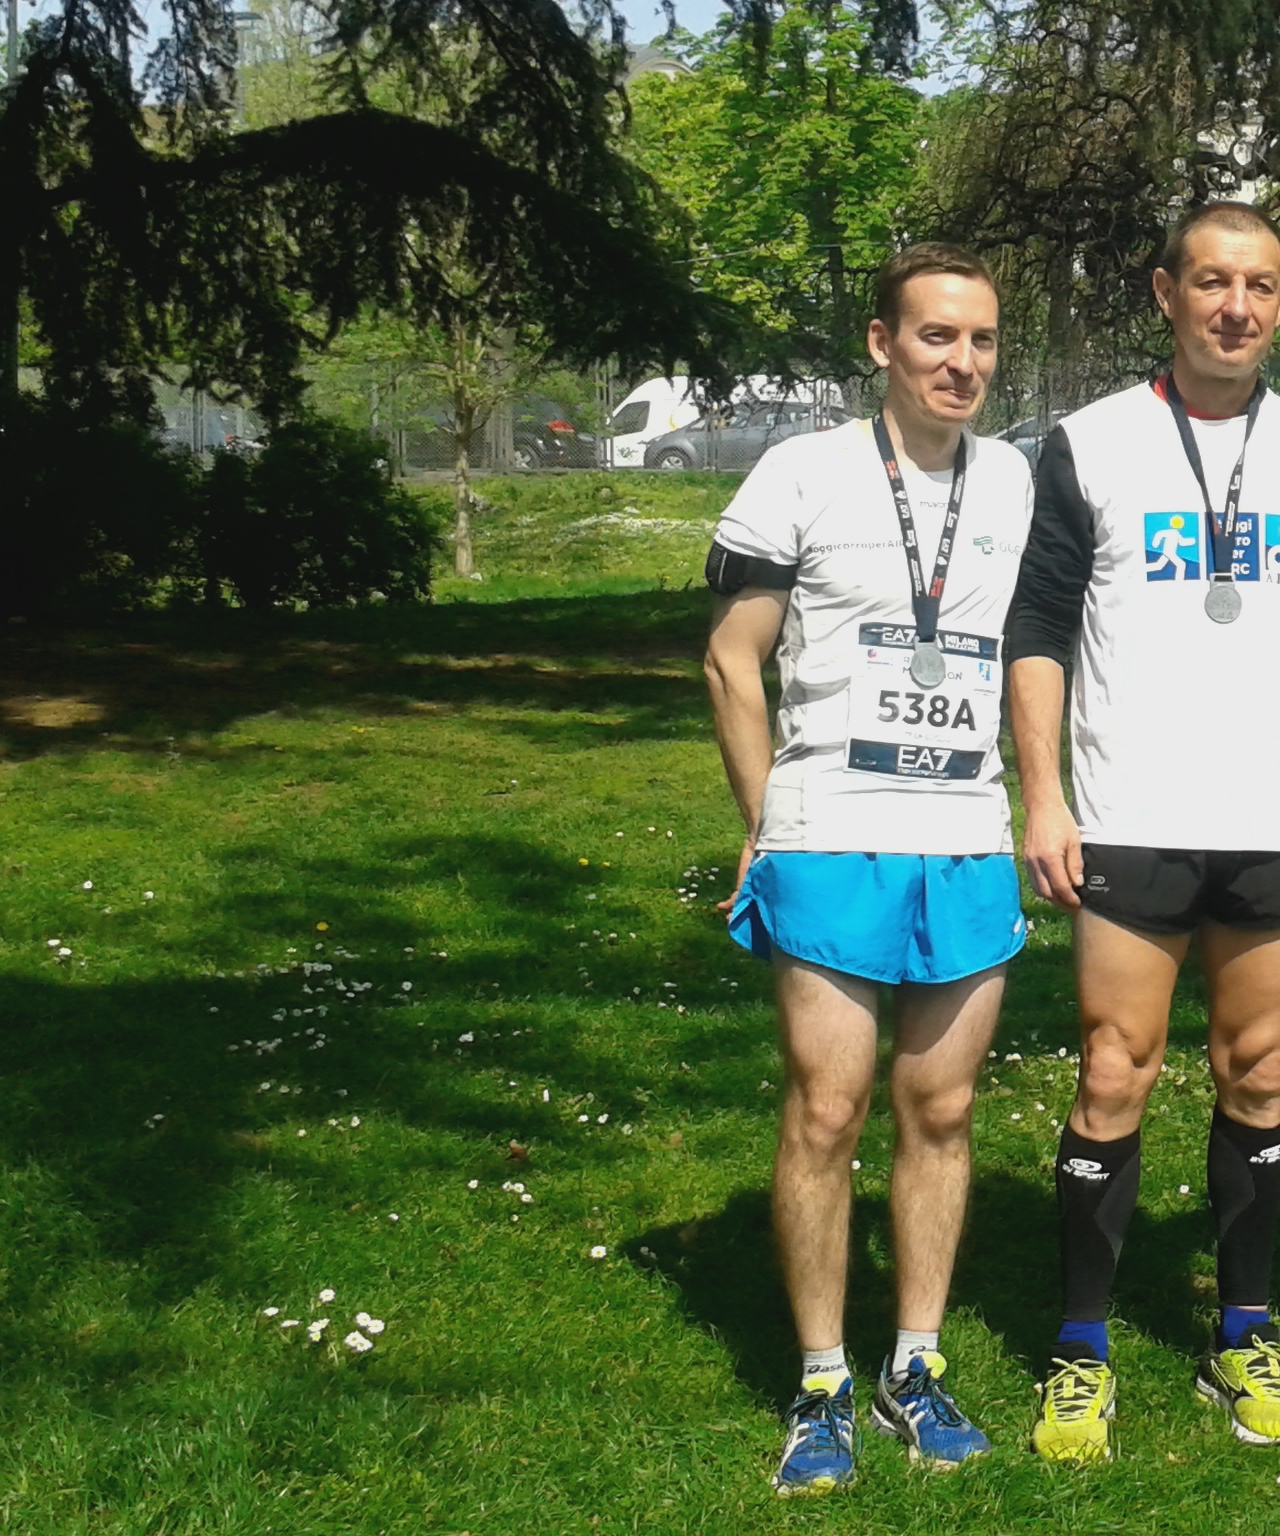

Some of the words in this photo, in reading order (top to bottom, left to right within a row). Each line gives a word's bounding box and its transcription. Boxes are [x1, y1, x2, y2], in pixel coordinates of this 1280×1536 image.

[882, 626, 917, 643] EA7
[877, 690, 976, 731] 538A
[898, 746, 953, 771] EA7
